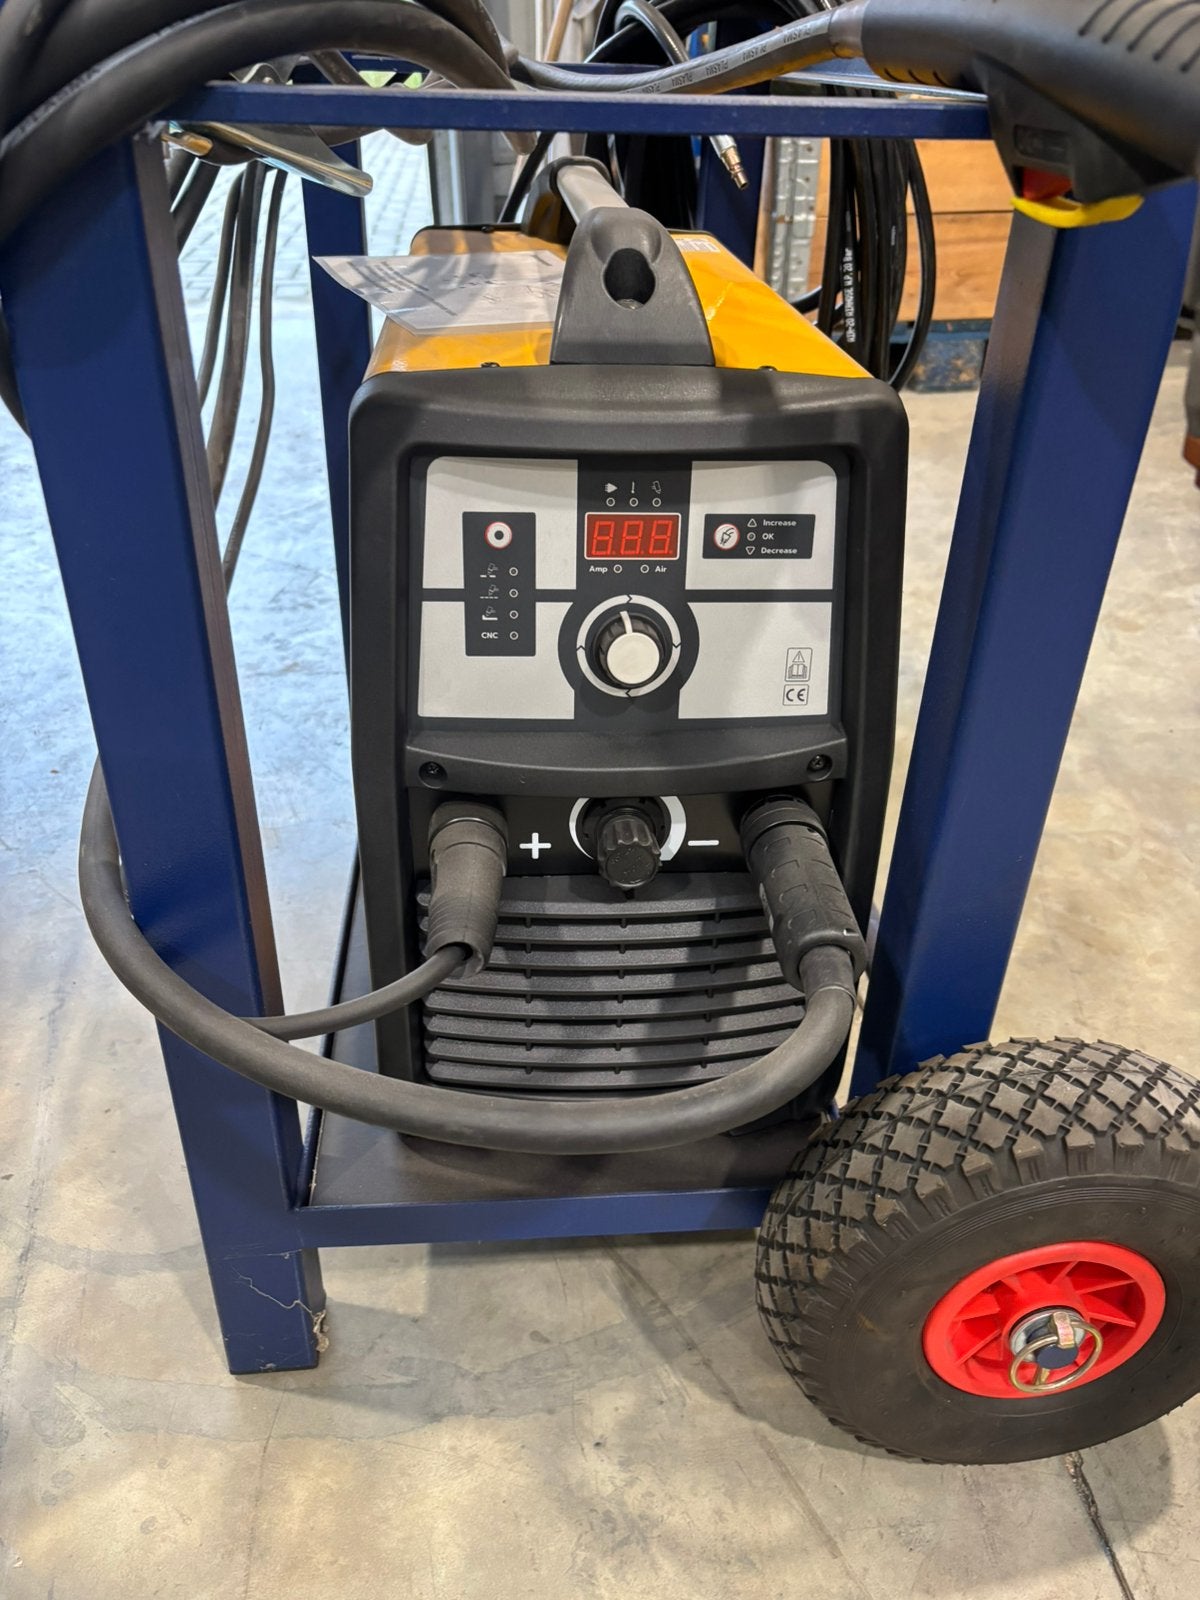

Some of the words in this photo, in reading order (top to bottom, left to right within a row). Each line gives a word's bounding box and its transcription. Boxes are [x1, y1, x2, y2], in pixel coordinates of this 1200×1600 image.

[742, 44, 768, 61] PLASMA
[705, 60, 729, 76] PLASMA
[671, 72, 694, 87] PLASMA
[843, 247, 853, 262] Bar
[762, 519, 797, 527] Increase
[762, 532, 774, 541] OK
[760, 546, 798, 555] Decrease
[589, 565, 608, 574] Amp
[655, 565, 667, 573] Air
[481, 631, 499, 639] CNC
[785, 688, 806, 702] CE
